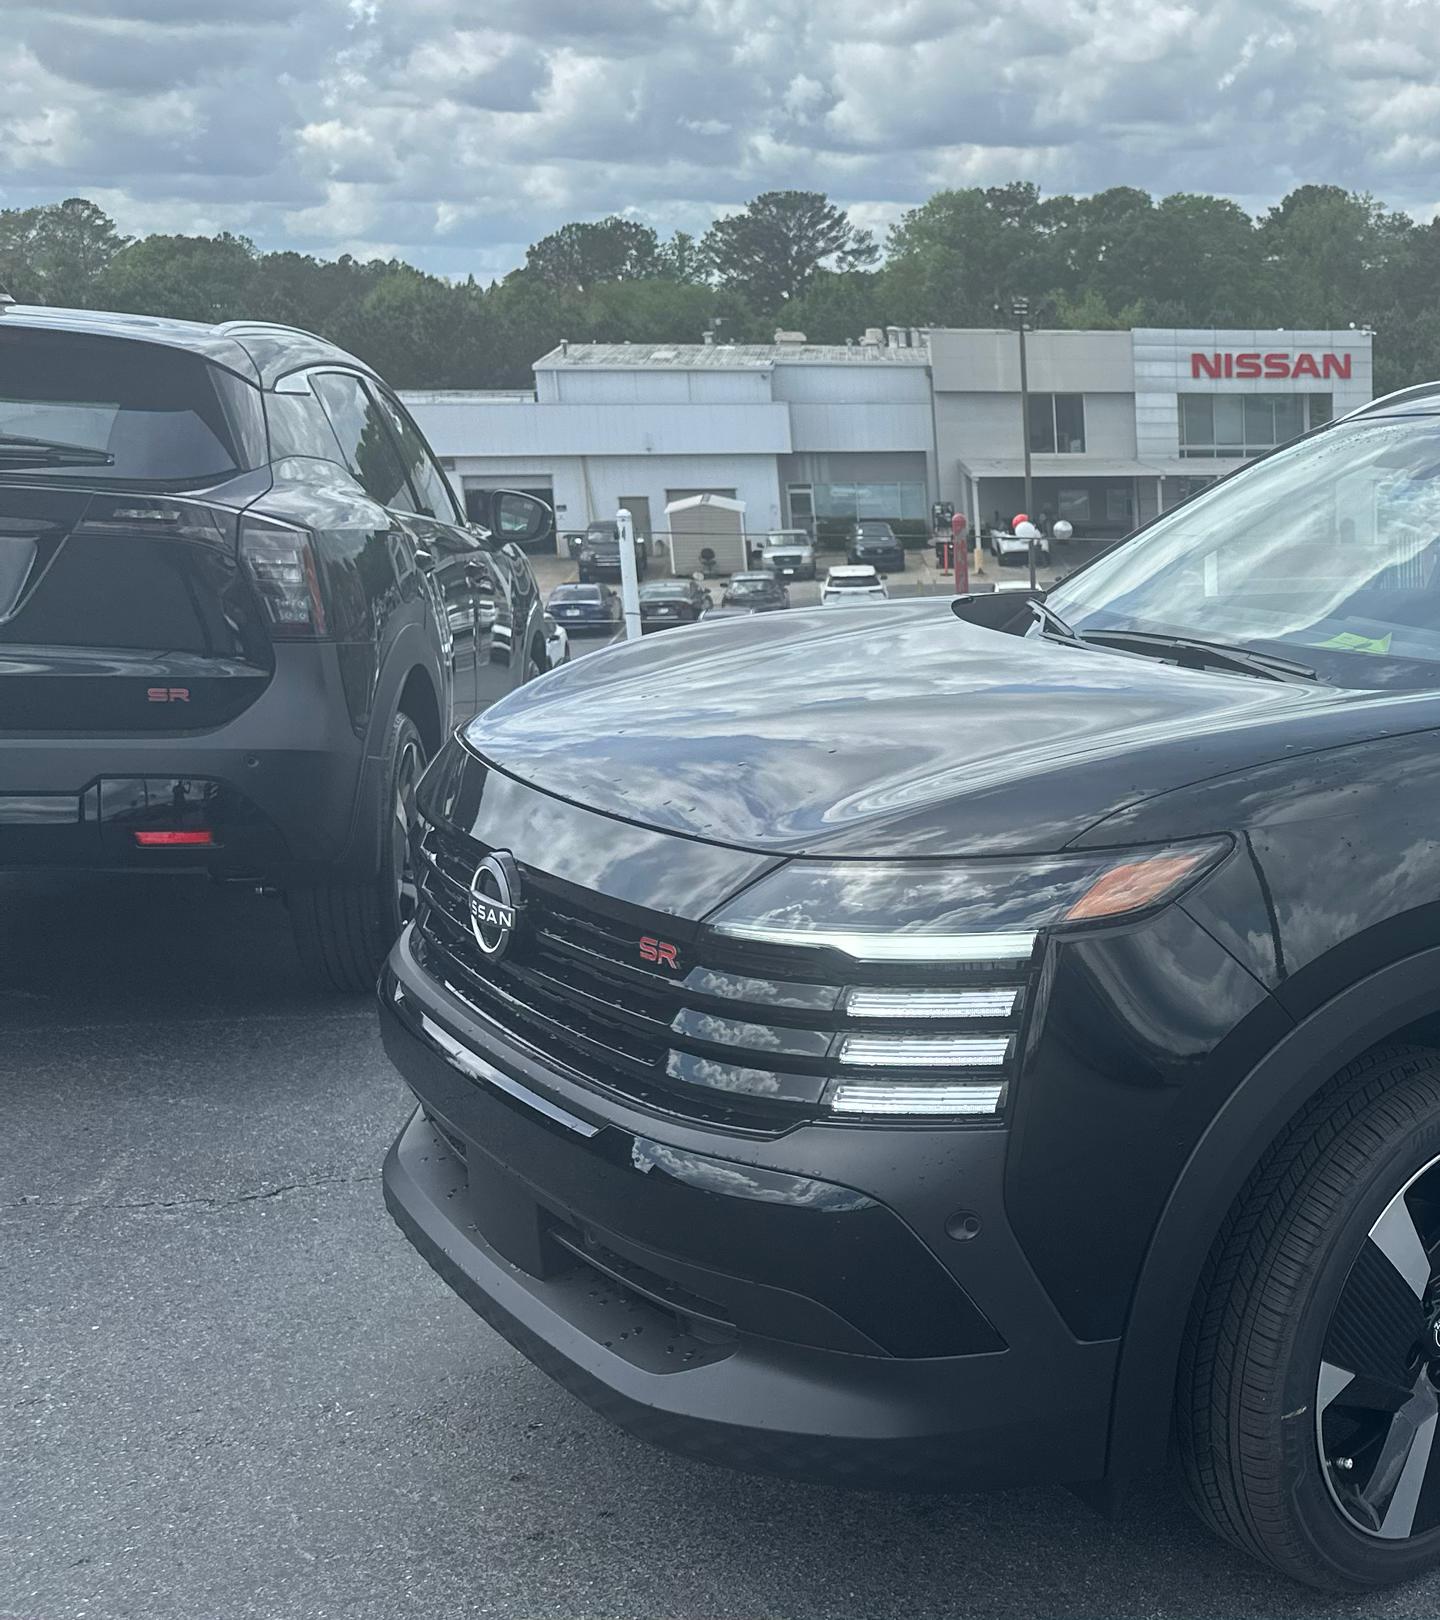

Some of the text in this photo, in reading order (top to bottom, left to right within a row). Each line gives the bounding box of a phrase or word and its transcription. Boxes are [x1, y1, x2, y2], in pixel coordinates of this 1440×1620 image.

[1191, 353, 1351, 379] NISSAN
[147, 687, 190, 702] SR
[471, 899, 512, 928] SSAN
[640, 936, 678, 969] SR
